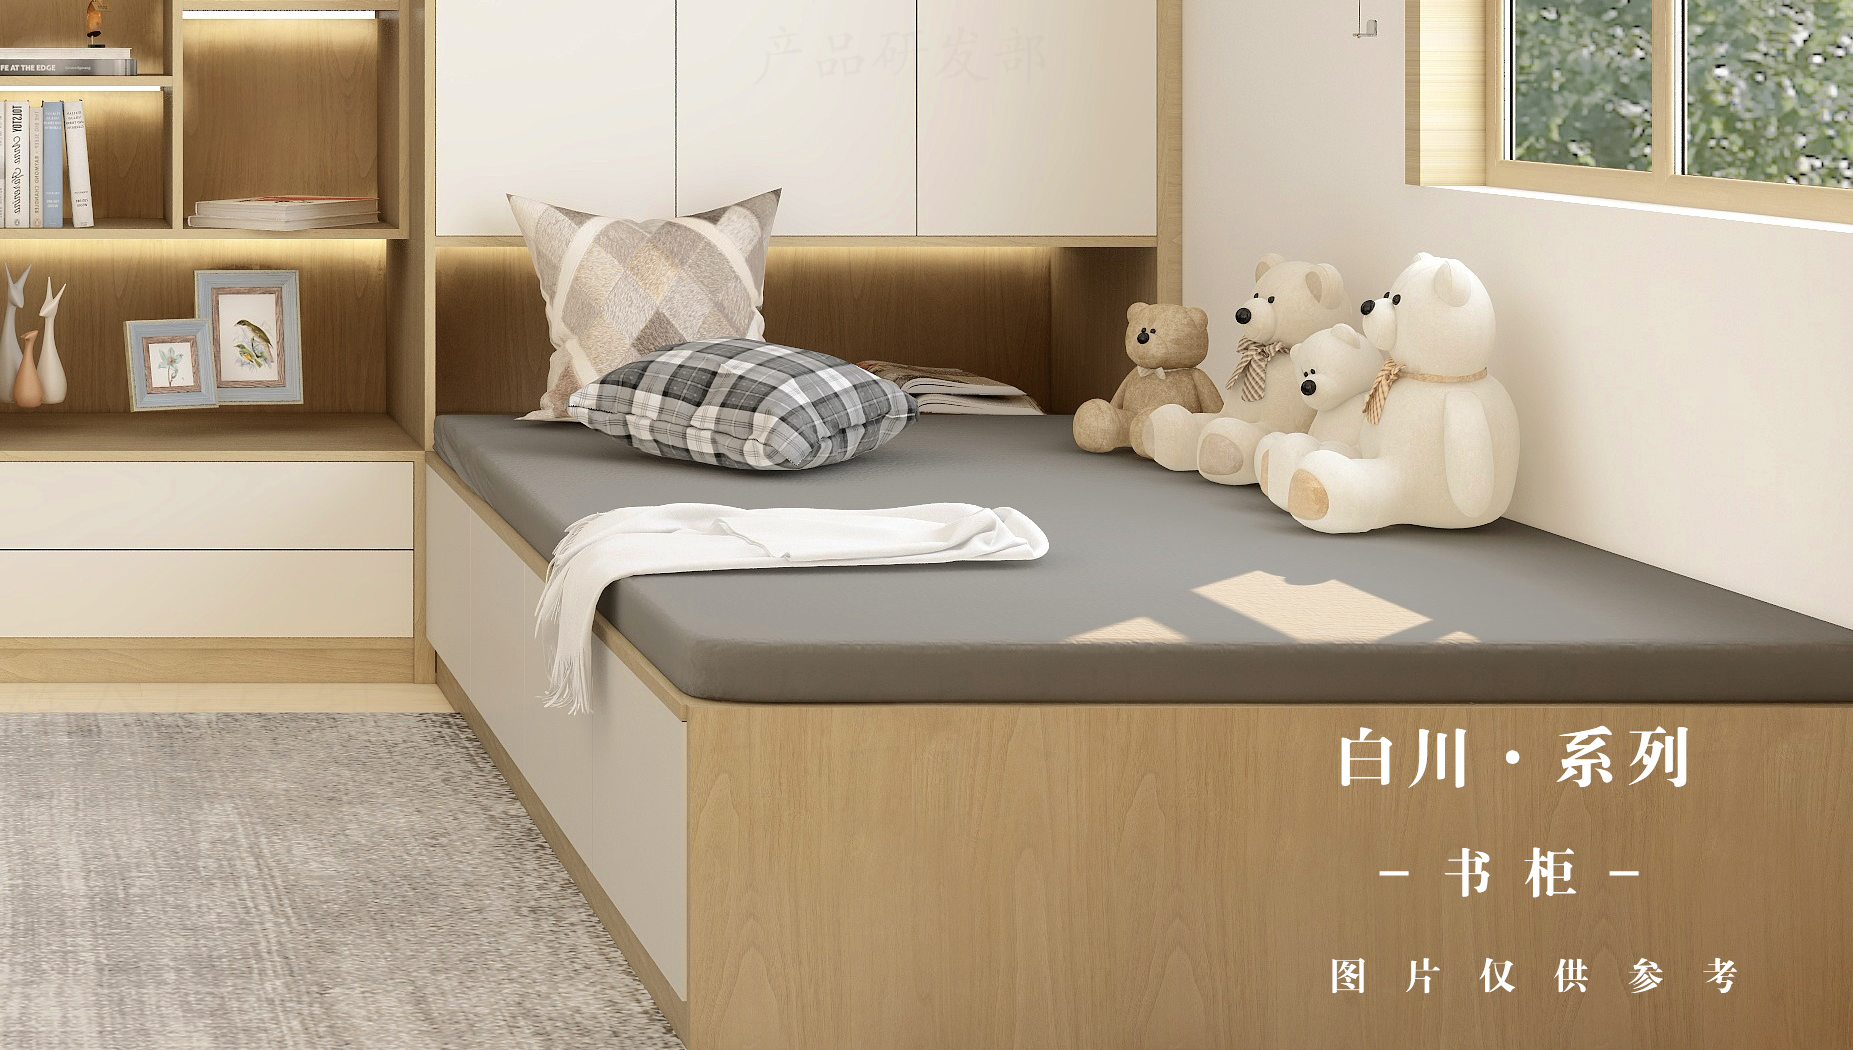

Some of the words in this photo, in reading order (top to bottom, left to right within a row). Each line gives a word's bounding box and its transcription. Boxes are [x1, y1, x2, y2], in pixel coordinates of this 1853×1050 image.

[10, 64, 20, 72] AT
[21, 64, 35, 72] THE
[36, 64, 56, 72] EDGE
